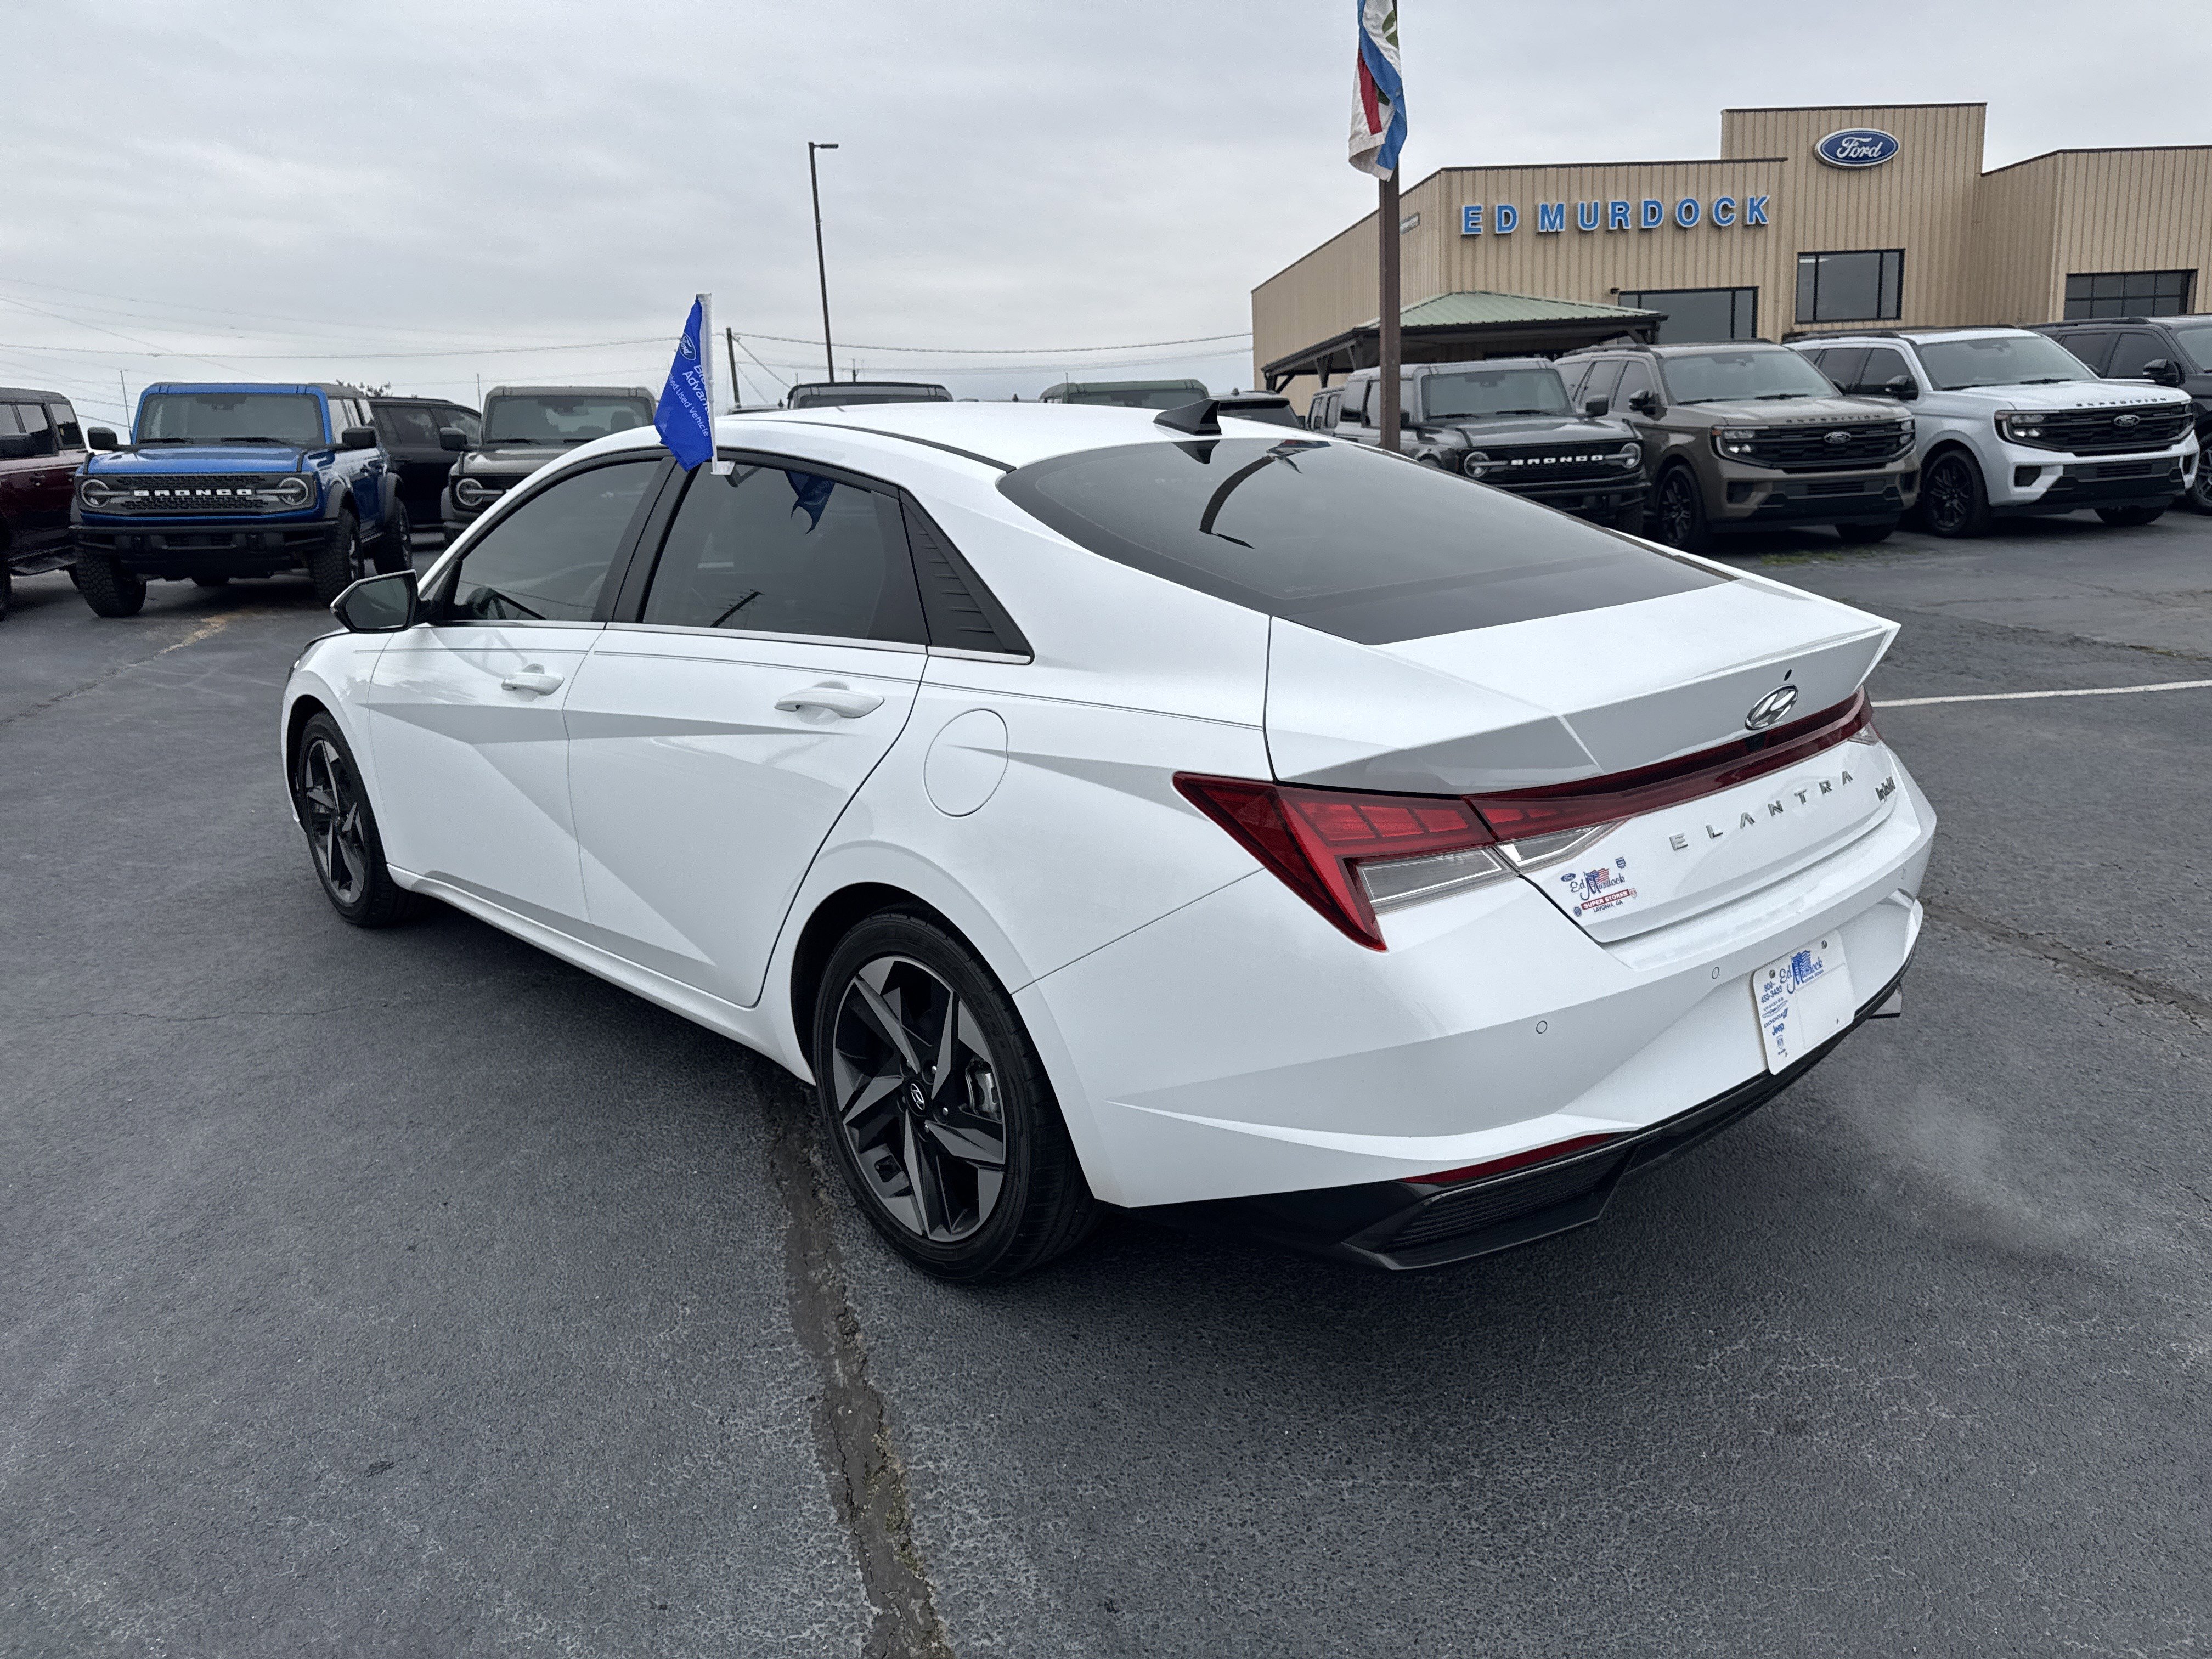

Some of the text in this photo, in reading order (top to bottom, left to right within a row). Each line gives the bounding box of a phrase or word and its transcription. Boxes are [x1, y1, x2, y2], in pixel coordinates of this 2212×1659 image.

[1836, 136, 1883, 159] Ford
[1462, 195, 1770, 235] ED MURDOCK
[675, 388, 709, 437] Used Vehicle
[1511, 454, 1603, 465] BRONCO
[1669, 770, 1853, 851] ELANTRA
[1570, 873, 1626, 901] Ed Murdock
[1583, 890, 1628, 909] SUPER STORES
[1593, 902, 1616, 913] LAVONIA,
[1779, 964, 1792, 984] Ed
[1772, 1023, 1784, 1036] Jeep
